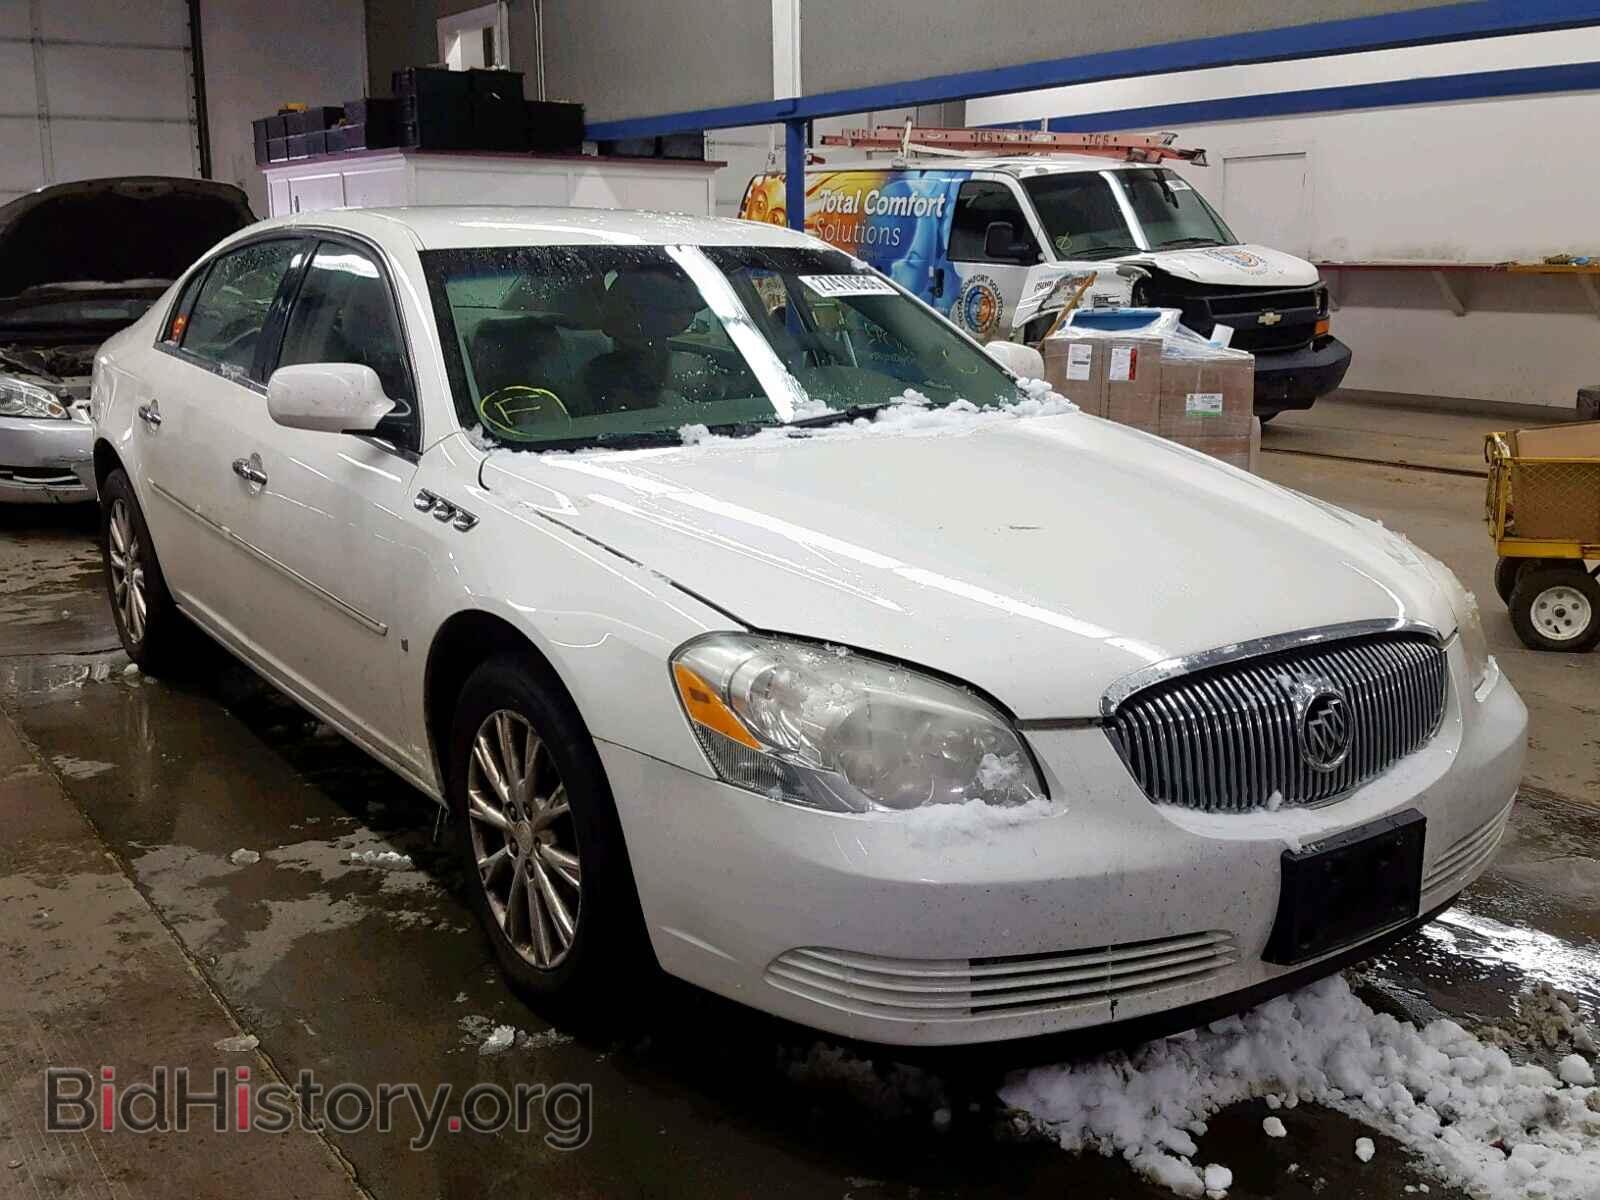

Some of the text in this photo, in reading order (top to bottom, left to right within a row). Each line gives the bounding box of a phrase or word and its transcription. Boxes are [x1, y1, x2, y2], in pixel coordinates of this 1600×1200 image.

[1088, 134, 1109, 145] TCS
[818, 189, 946, 218] Total Comfort
[816, 217, 901, 246] Solutions
